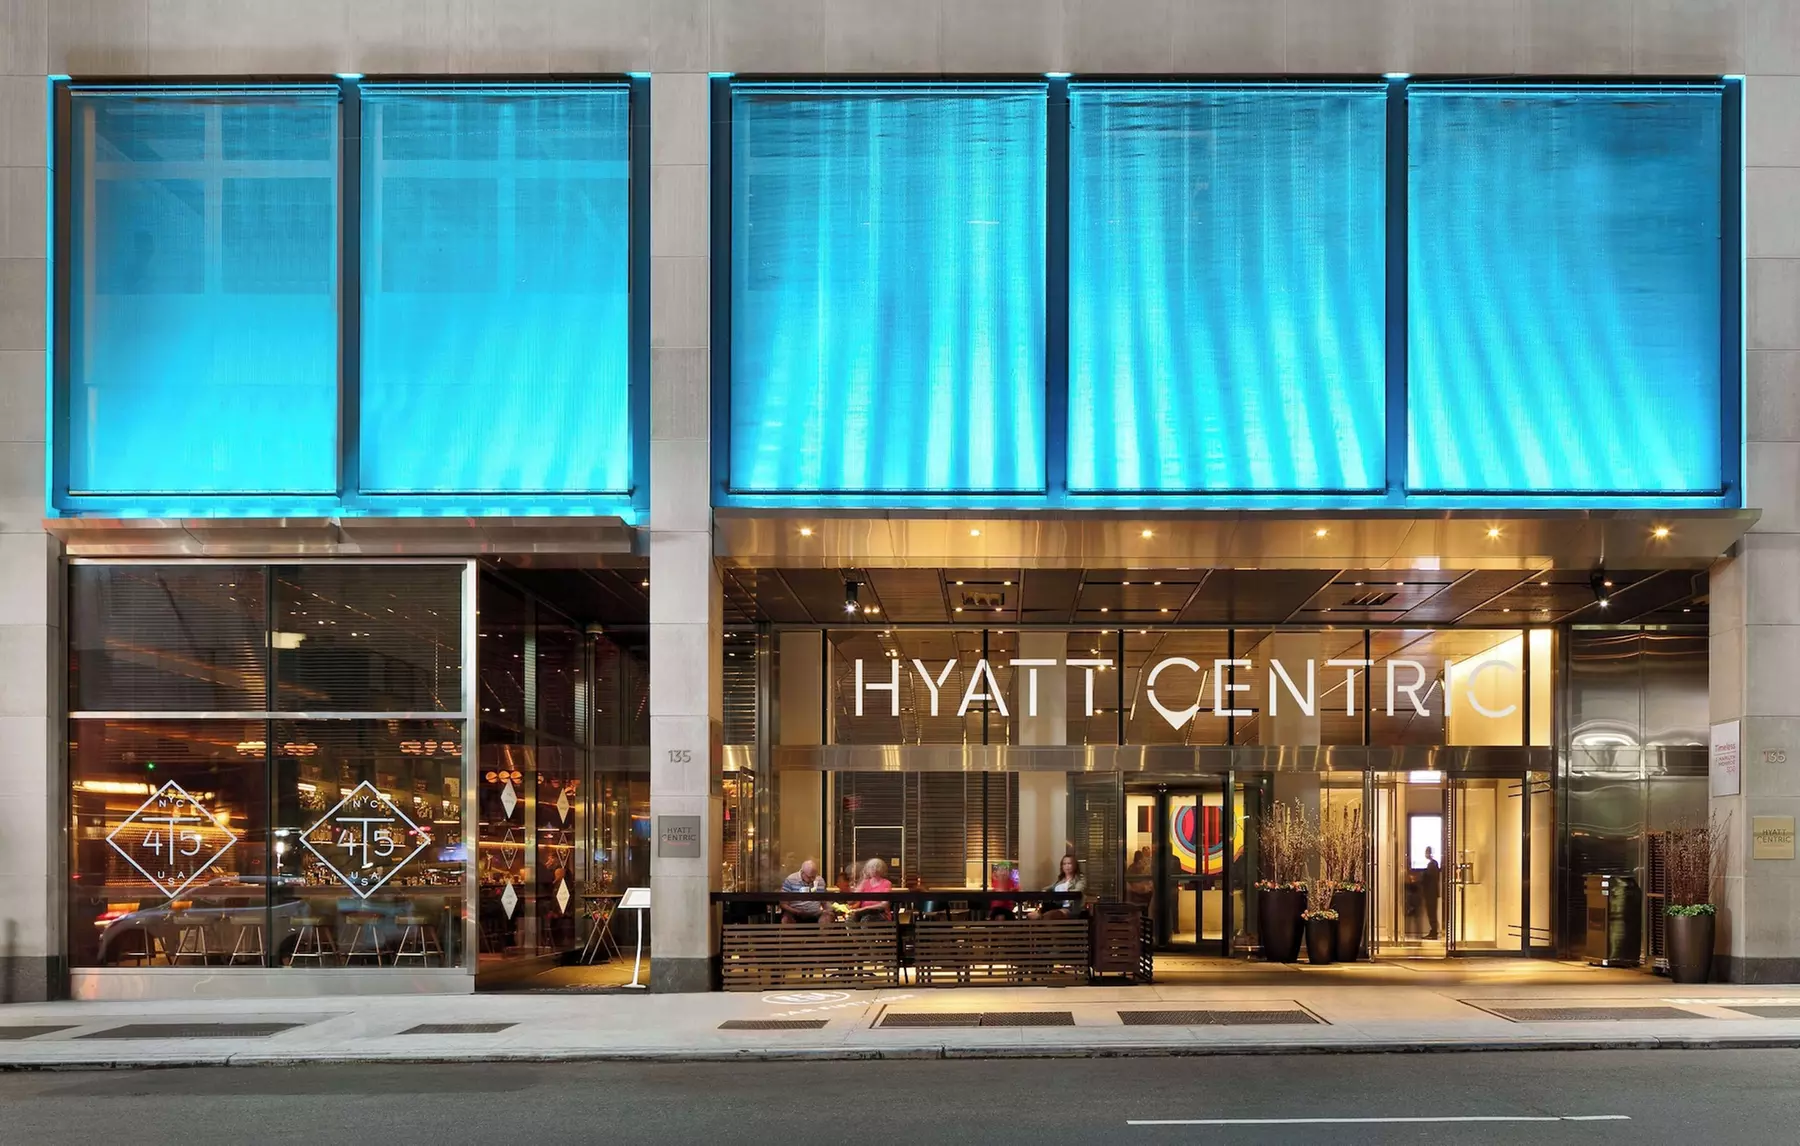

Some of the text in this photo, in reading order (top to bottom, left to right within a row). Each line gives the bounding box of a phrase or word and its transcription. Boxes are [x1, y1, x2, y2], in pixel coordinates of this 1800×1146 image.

[855, 657, 1517, 731] HYATT CENTRIC
[668, 749, 692, 763] 135
[1763, 750, 1787, 764] 135
[159, 796, 184, 807] NYC
[353, 795, 378, 808] NYC
[661, 834, 697, 842] CENTRIC
[1757, 836, 1791, 844] CENTRIC
[158, 871, 185, 886] USA
[351, 871, 379, 886] USA
